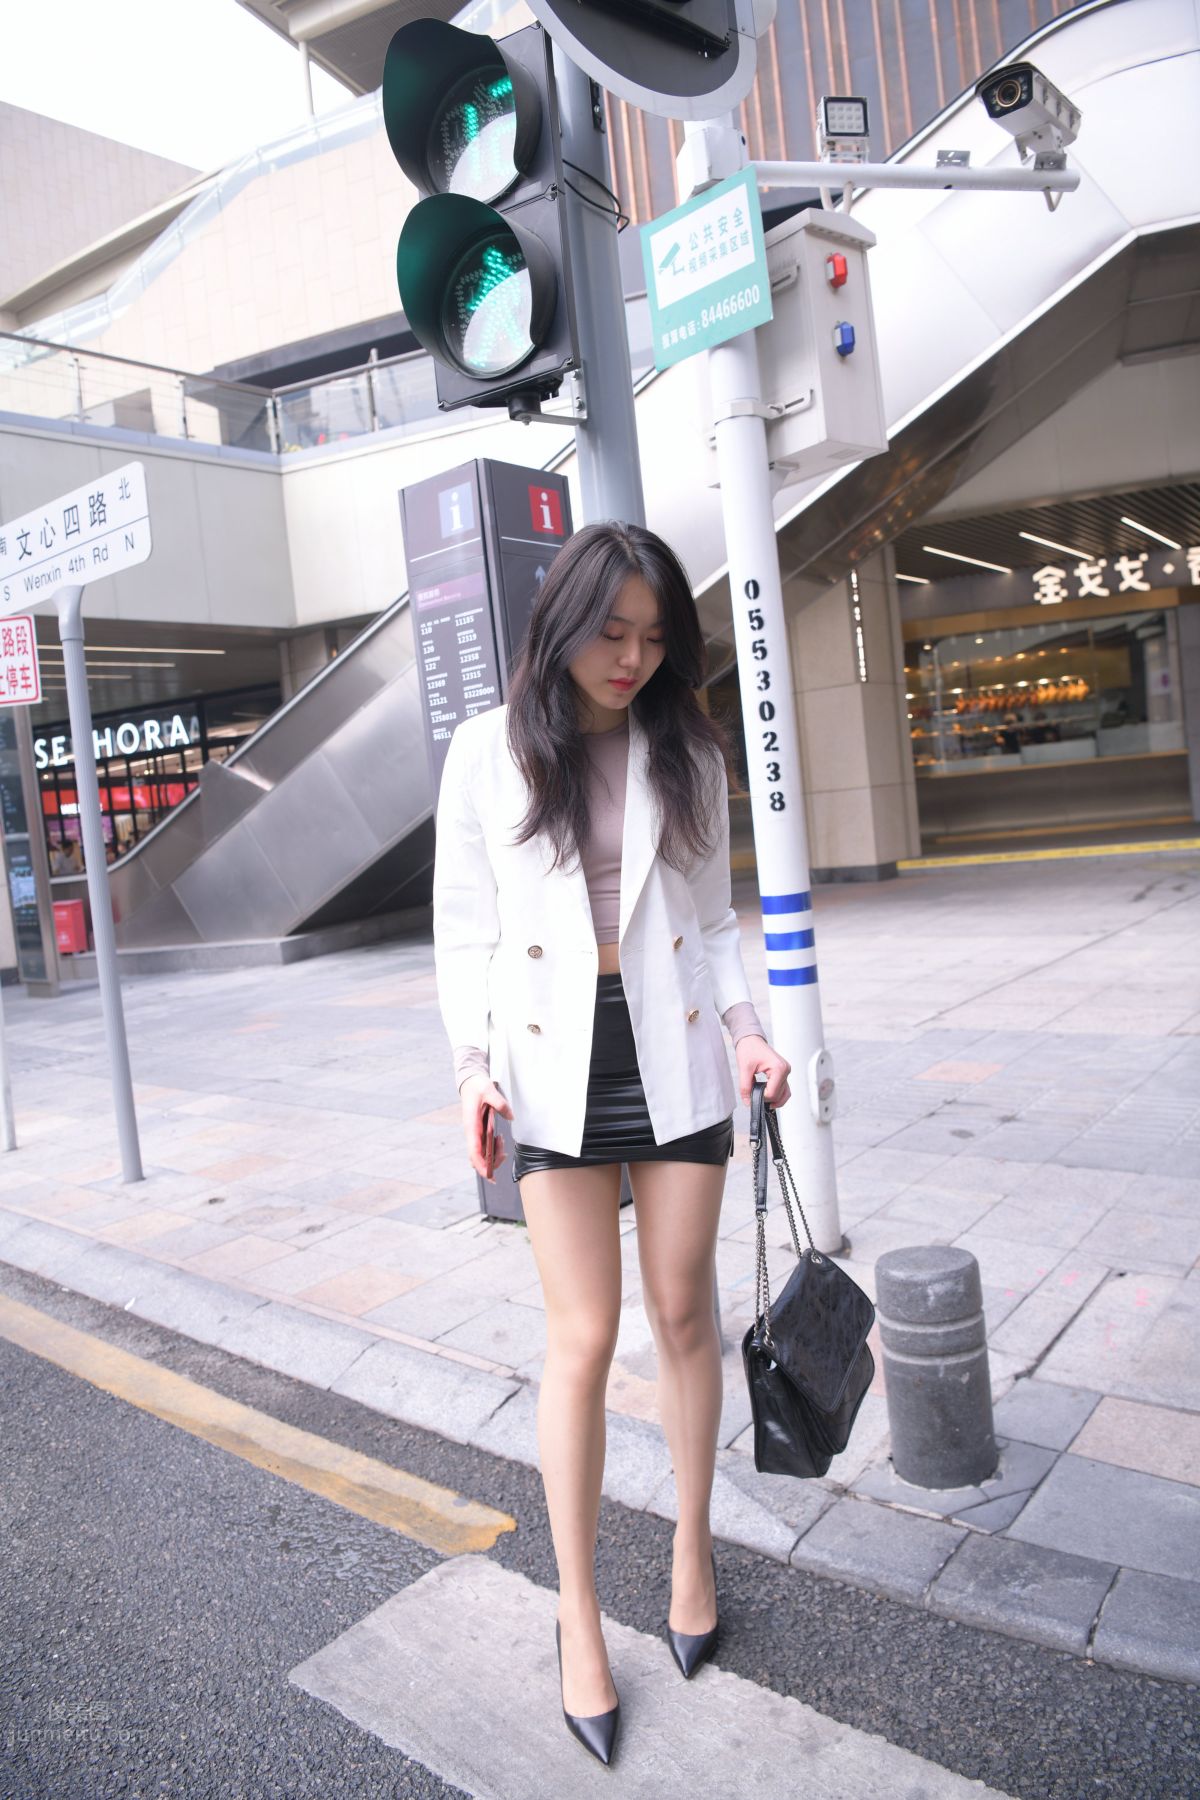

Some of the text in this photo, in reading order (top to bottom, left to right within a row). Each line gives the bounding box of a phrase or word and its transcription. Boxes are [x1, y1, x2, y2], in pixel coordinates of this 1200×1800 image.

[688, 207, 744, 252] 公共安全
[16, 491, 107, 560] 文心四路
[118, 477, 131, 502] 北
[3, 532, 135, 602] S Wenxin 4th Rd N
[0, 626, 29, 658] 路段
[744, 579, 786, 812] 05530238
[34, 715, 190, 769] SEHORA
